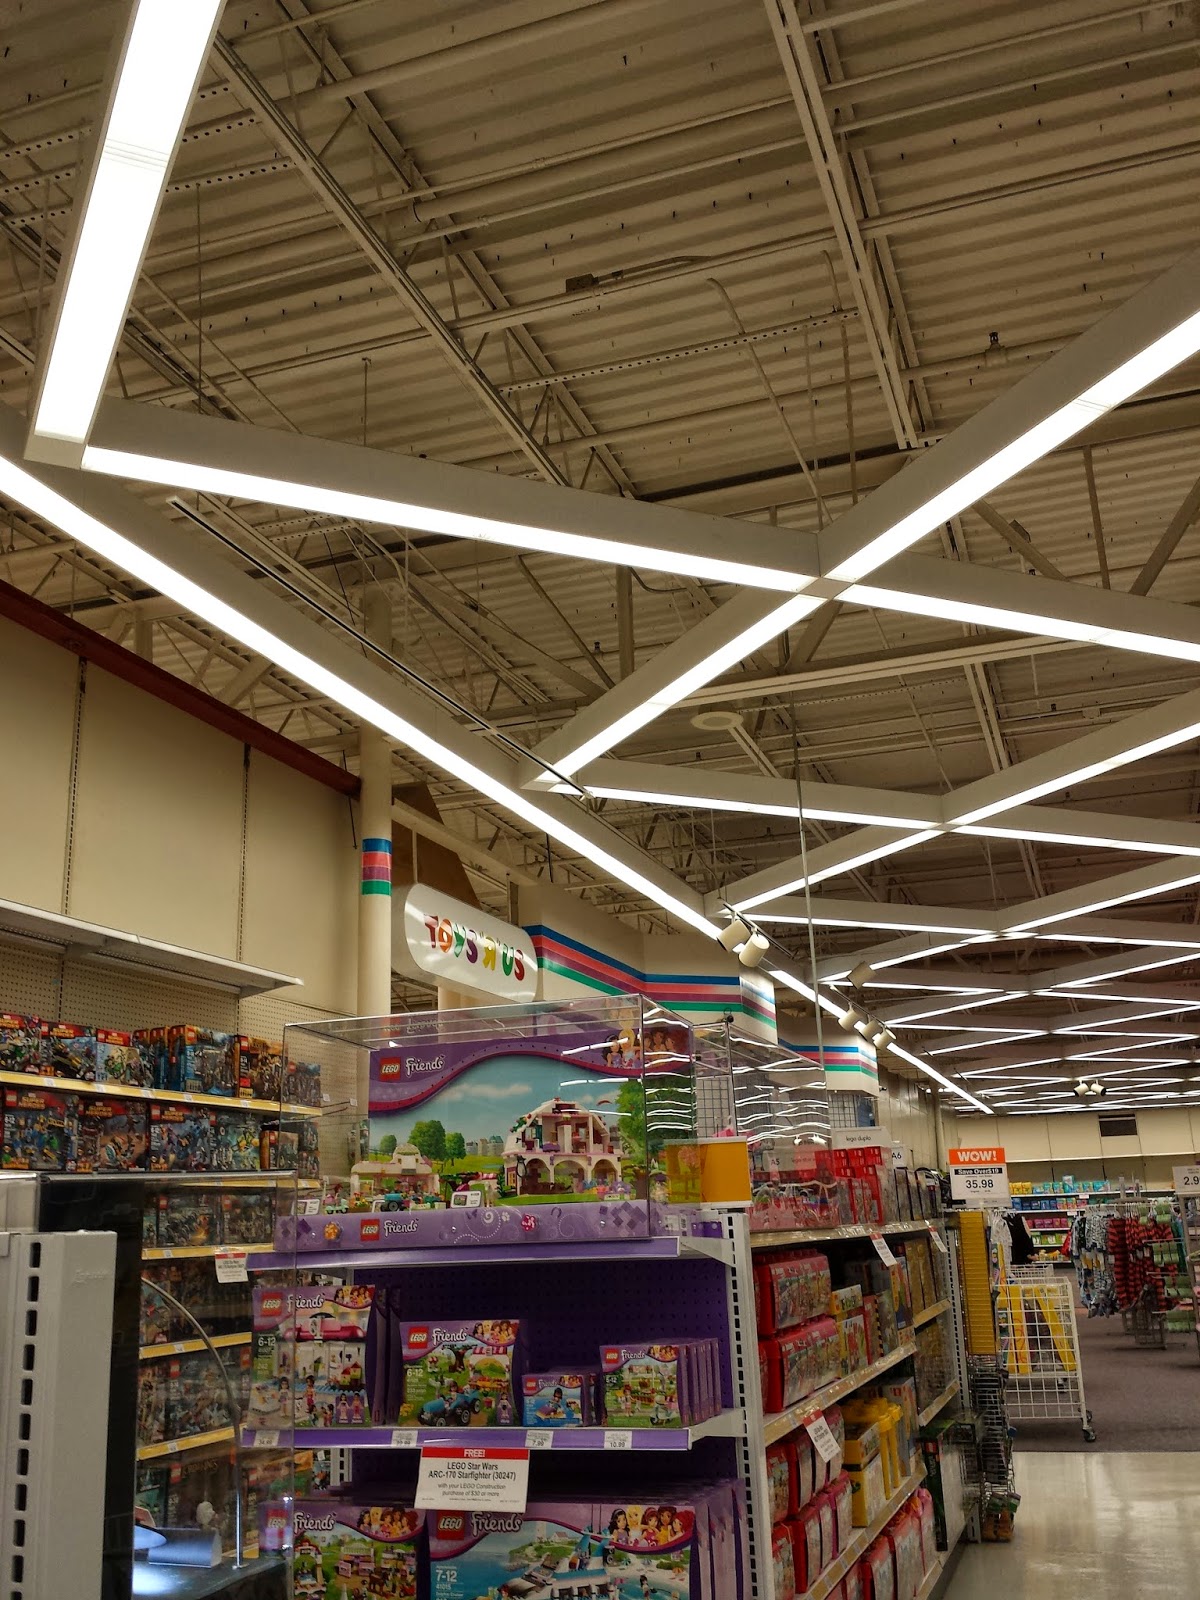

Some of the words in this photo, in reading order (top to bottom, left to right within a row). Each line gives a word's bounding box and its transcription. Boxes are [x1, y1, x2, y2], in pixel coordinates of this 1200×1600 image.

[423, 914, 478, 964] TOYS
[502, 943, 525, 981] US
[957, 1150, 998, 1162] WOW!
[965, 1179, 994, 1189] 35.98
[362, 1225, 379, 1234] LEGO
[263, 1298, 281, 1309] LEGO
[258, 1336, 277, 1347] 6-12
[409, 1333, 427, 1343] LEGO
[406, 1368, 424, 1377] 6-12
[463, 1449, 486, 1458] FREE!
[447, 1461, 466, 1470] LEGO
[467, 1462, 481, 1470] Star
[482, 1462, 499, 1470] Wars
[428, 1470, 456, 1479] ARC-170
[457, 1471, 491, 1481] Starfighter
[492, 1471, 517, 1481] (30247)
[267, 1517, 287, 1529] LEGO
[439, 1516, 463, 1530] LEGO
[435, 1569, 457, 1582] 7-12
